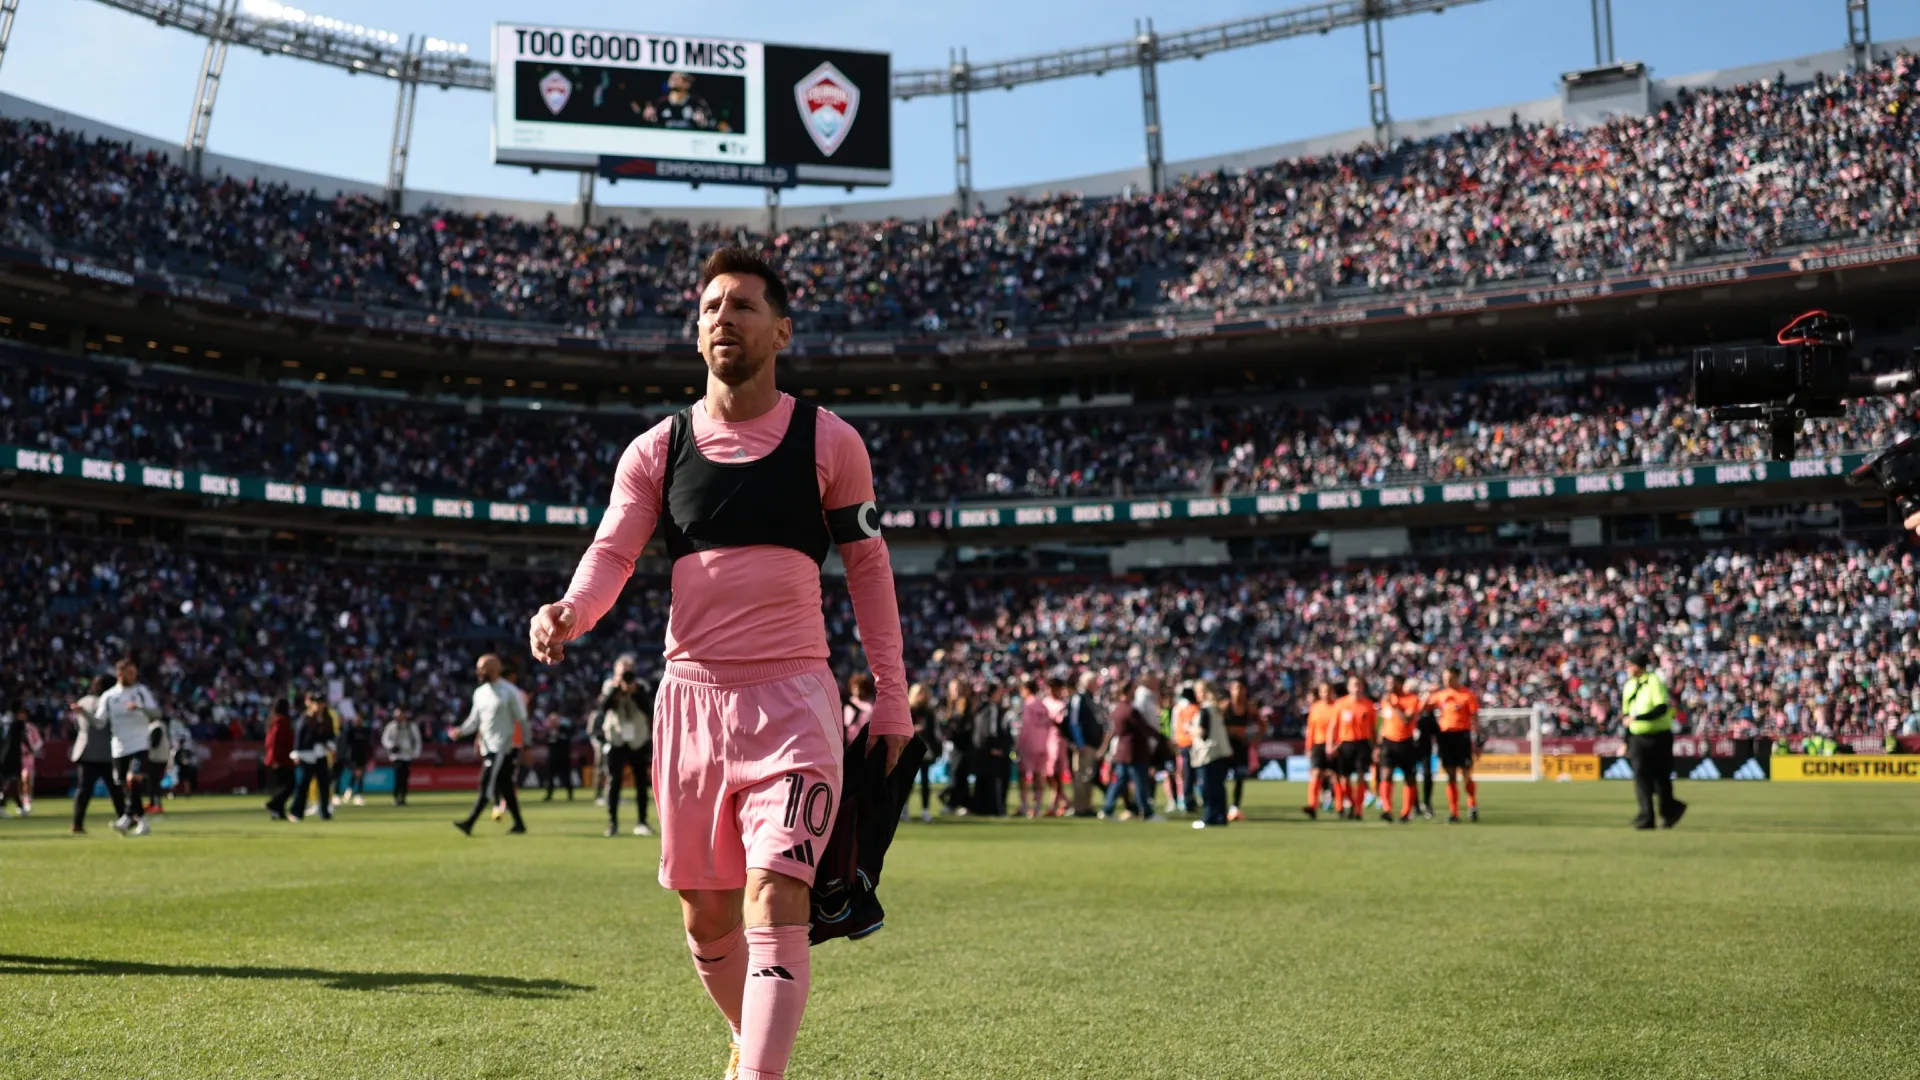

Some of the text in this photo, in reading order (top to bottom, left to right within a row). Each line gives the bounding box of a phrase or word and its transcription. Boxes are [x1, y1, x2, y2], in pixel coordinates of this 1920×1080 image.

[515, 30, 746, 69] TOO GOOD TO MISS
[656, 161, 788, 182] EMPOWER FIELD
[1556, 756, 1594, 773] Tire
[1803, 759, 1920, 777] CONSTRUC
[783, 772, 833, 837] 10
